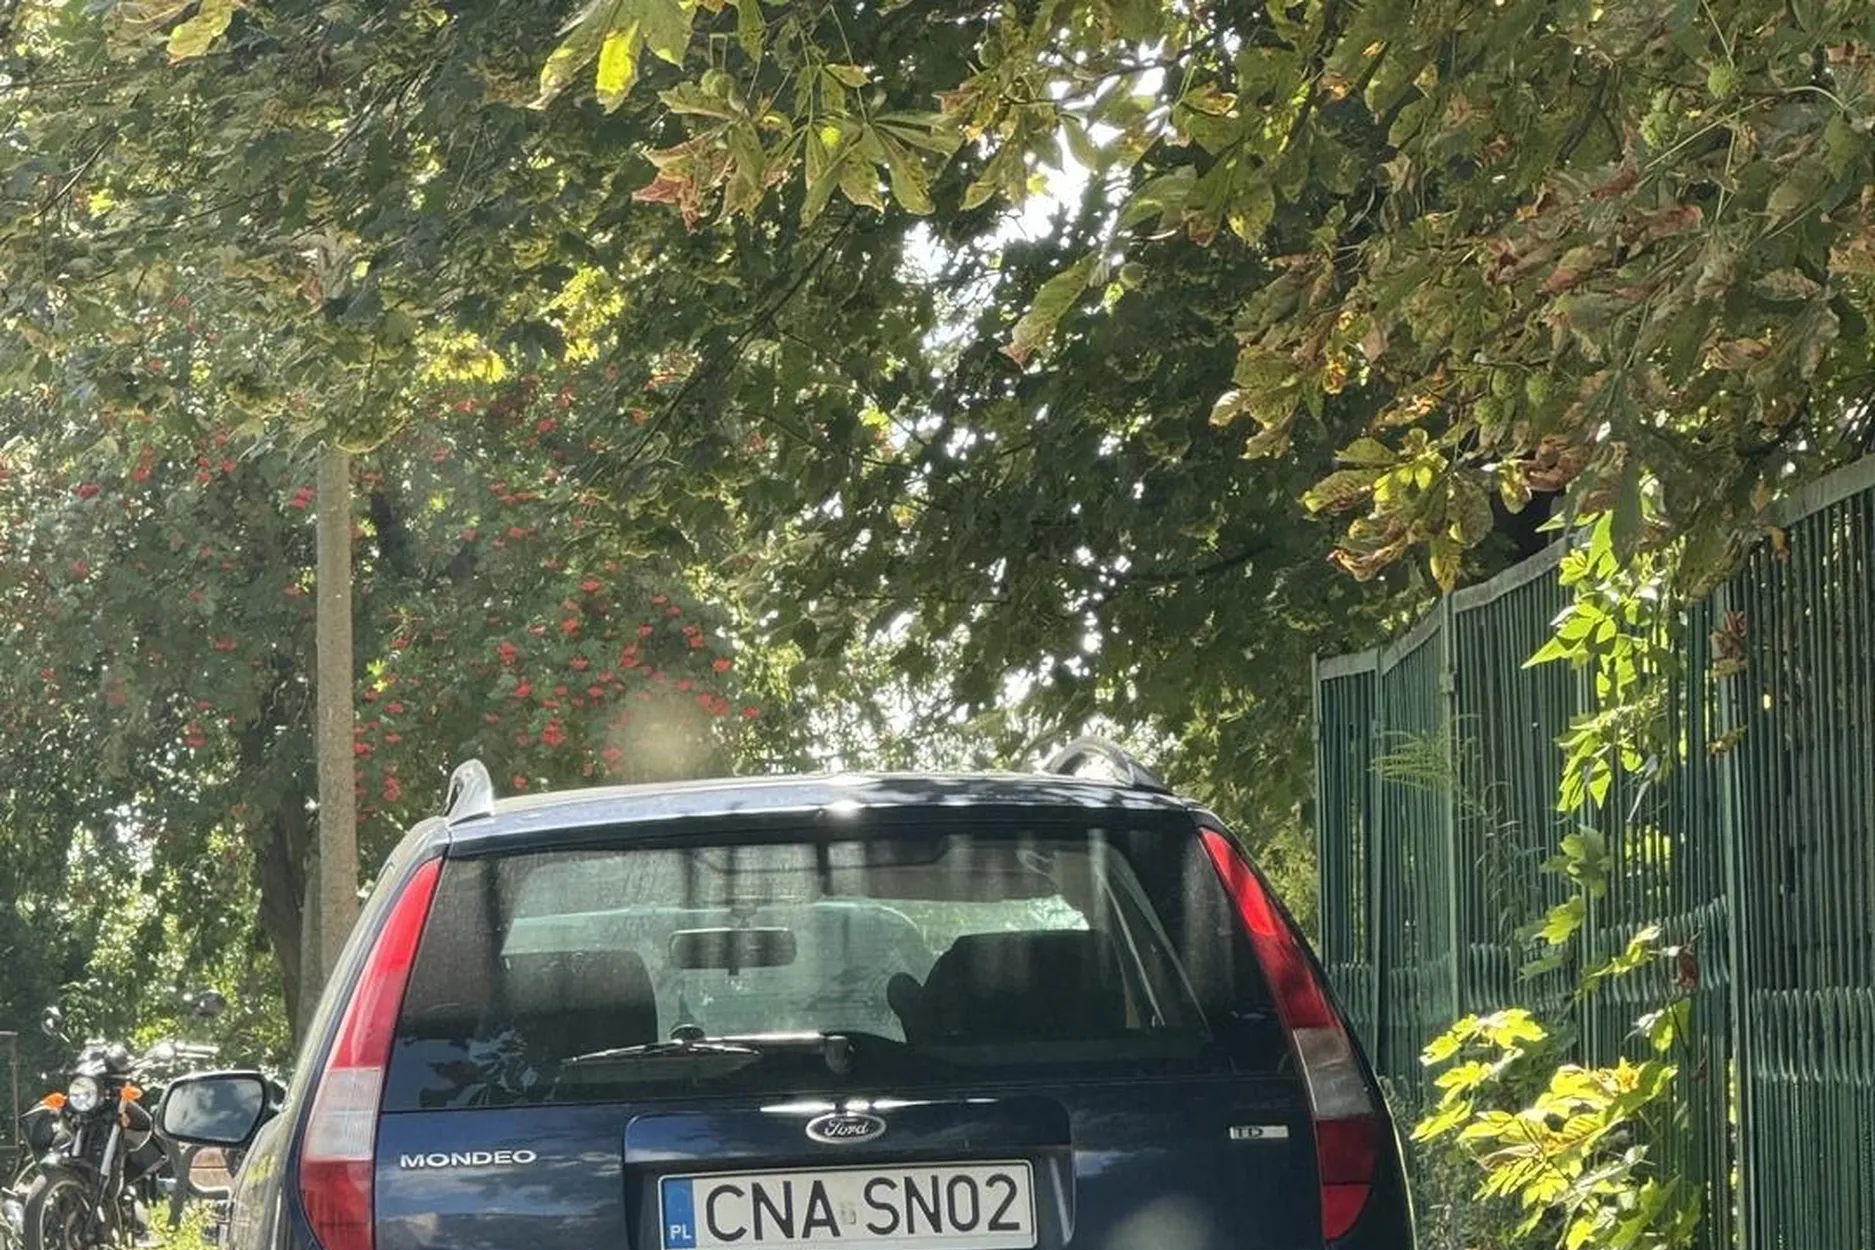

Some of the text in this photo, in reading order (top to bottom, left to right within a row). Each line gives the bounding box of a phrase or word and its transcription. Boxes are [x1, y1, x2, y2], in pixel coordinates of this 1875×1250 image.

[824, 1119, 869, 1137] Ford
[400, 1149, 537, 1168] MONDEO
[705, 1173, 1021, 1242] CNA SN02
[669, 1224, 693, 1241] PL
